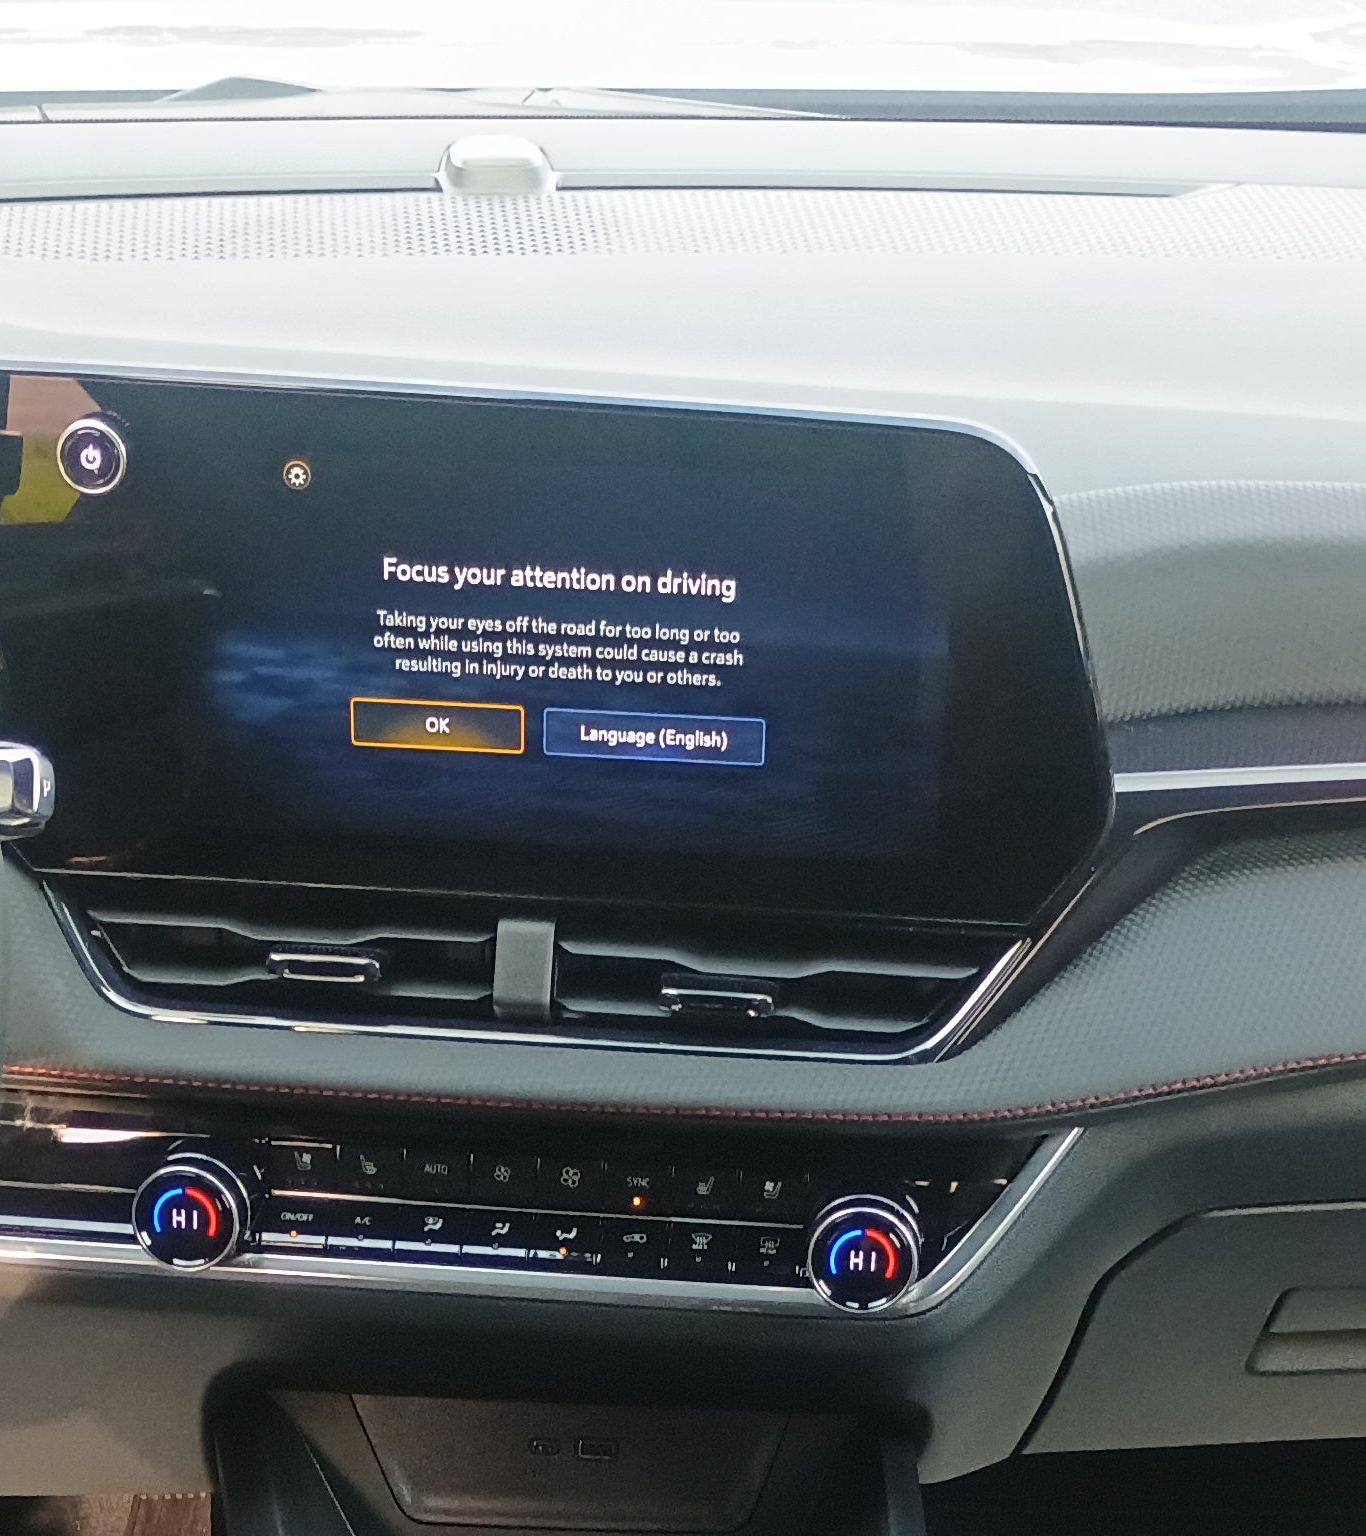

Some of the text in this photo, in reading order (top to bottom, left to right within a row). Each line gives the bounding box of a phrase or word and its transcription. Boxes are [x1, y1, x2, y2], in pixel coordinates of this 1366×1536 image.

[383, 556, 736, 603] Focus your attention on driving
[376, 609, 740, 645] Taking your eyes off the road for too long or too
[373, 632, 743, 666] often while using this system could cause a crash
[395, 656, 722, 687] resulting in injury or death to you or others.
[425, 717, 450, 734] OK
[580, 725, 729, 752] Language (English)
[424, 1163, 448, 1175] AUTO
[626, 1176, 650, 1189] SYNC
[172, 1209, 198, 1230] HI
[281, 1212, 313, 1222] ON/OFF
[355, 1216, 372, 1225] A/C
[850, 1251, 877, 1271] HI
